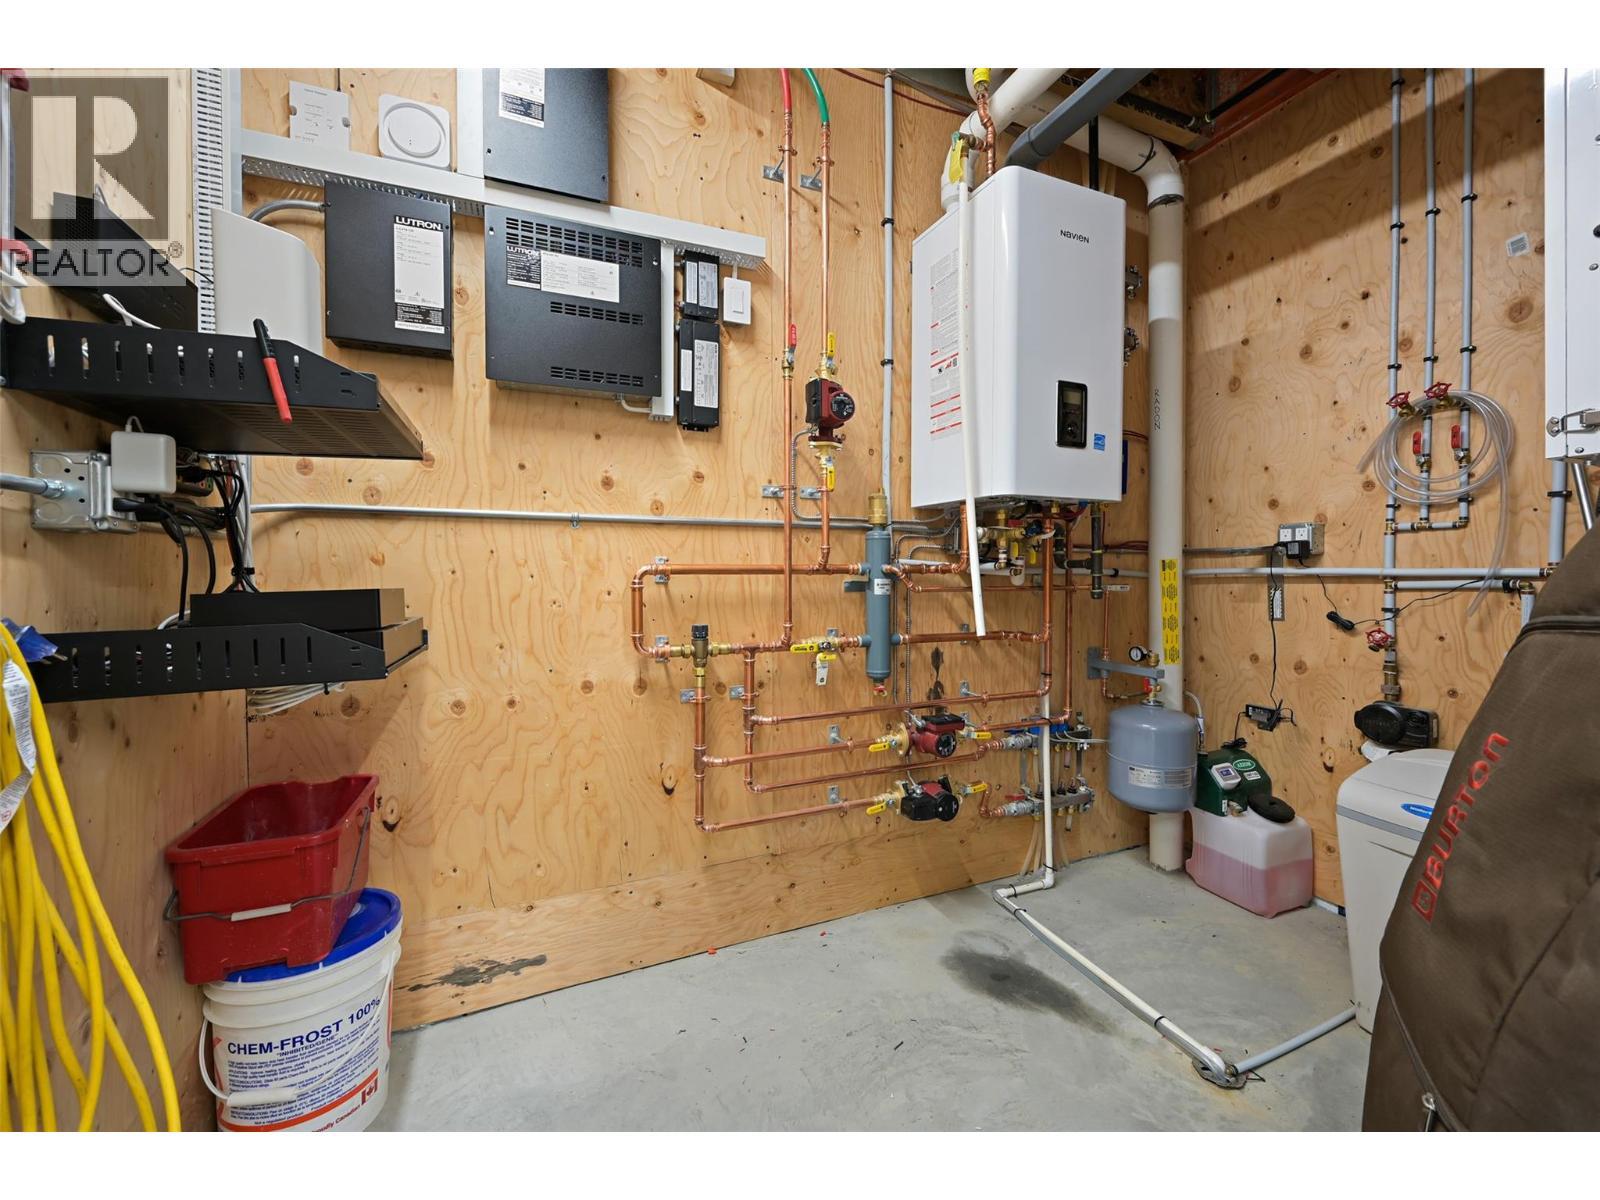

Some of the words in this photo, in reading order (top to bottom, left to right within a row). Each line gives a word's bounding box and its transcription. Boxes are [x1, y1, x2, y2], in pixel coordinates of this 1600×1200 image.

[395, 216, 442, 231] LUTRON
[1423, 732, 1511, 890] BURTON
[227, 1019, 344, 1055] CHEM-FROST
[348, 996, 381, 1025] 100%
